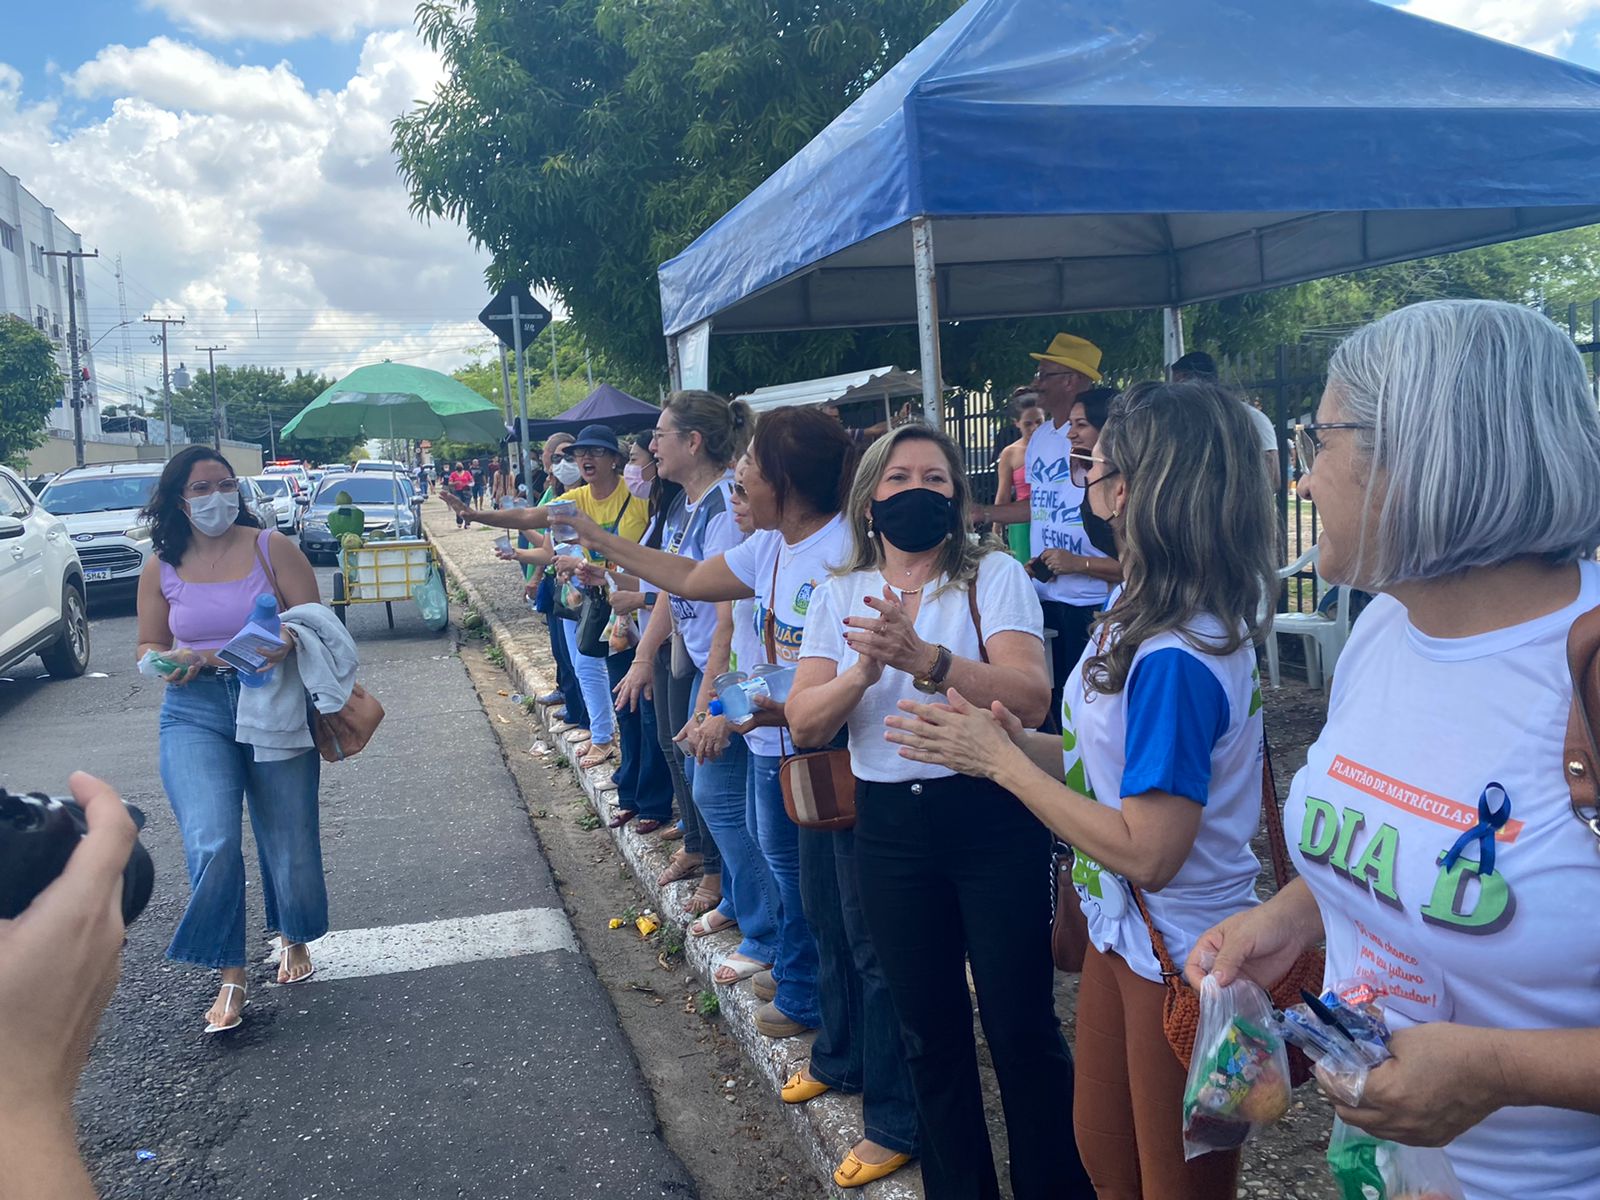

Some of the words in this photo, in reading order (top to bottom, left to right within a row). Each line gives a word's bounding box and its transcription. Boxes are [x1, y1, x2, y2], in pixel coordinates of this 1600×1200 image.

[1332, 760, 1373, 787] PLANTÃO
[1372, 778, 1386, 793] DE
[1385, 784, 1474, 825] MATRÍCULAS
[1298, 796, 1401, 907] DIA
[1420, 850, 1513, 932] D
[1384, 942, 1419, 966] chance
[1388, 962, 1424, 984] futuro
